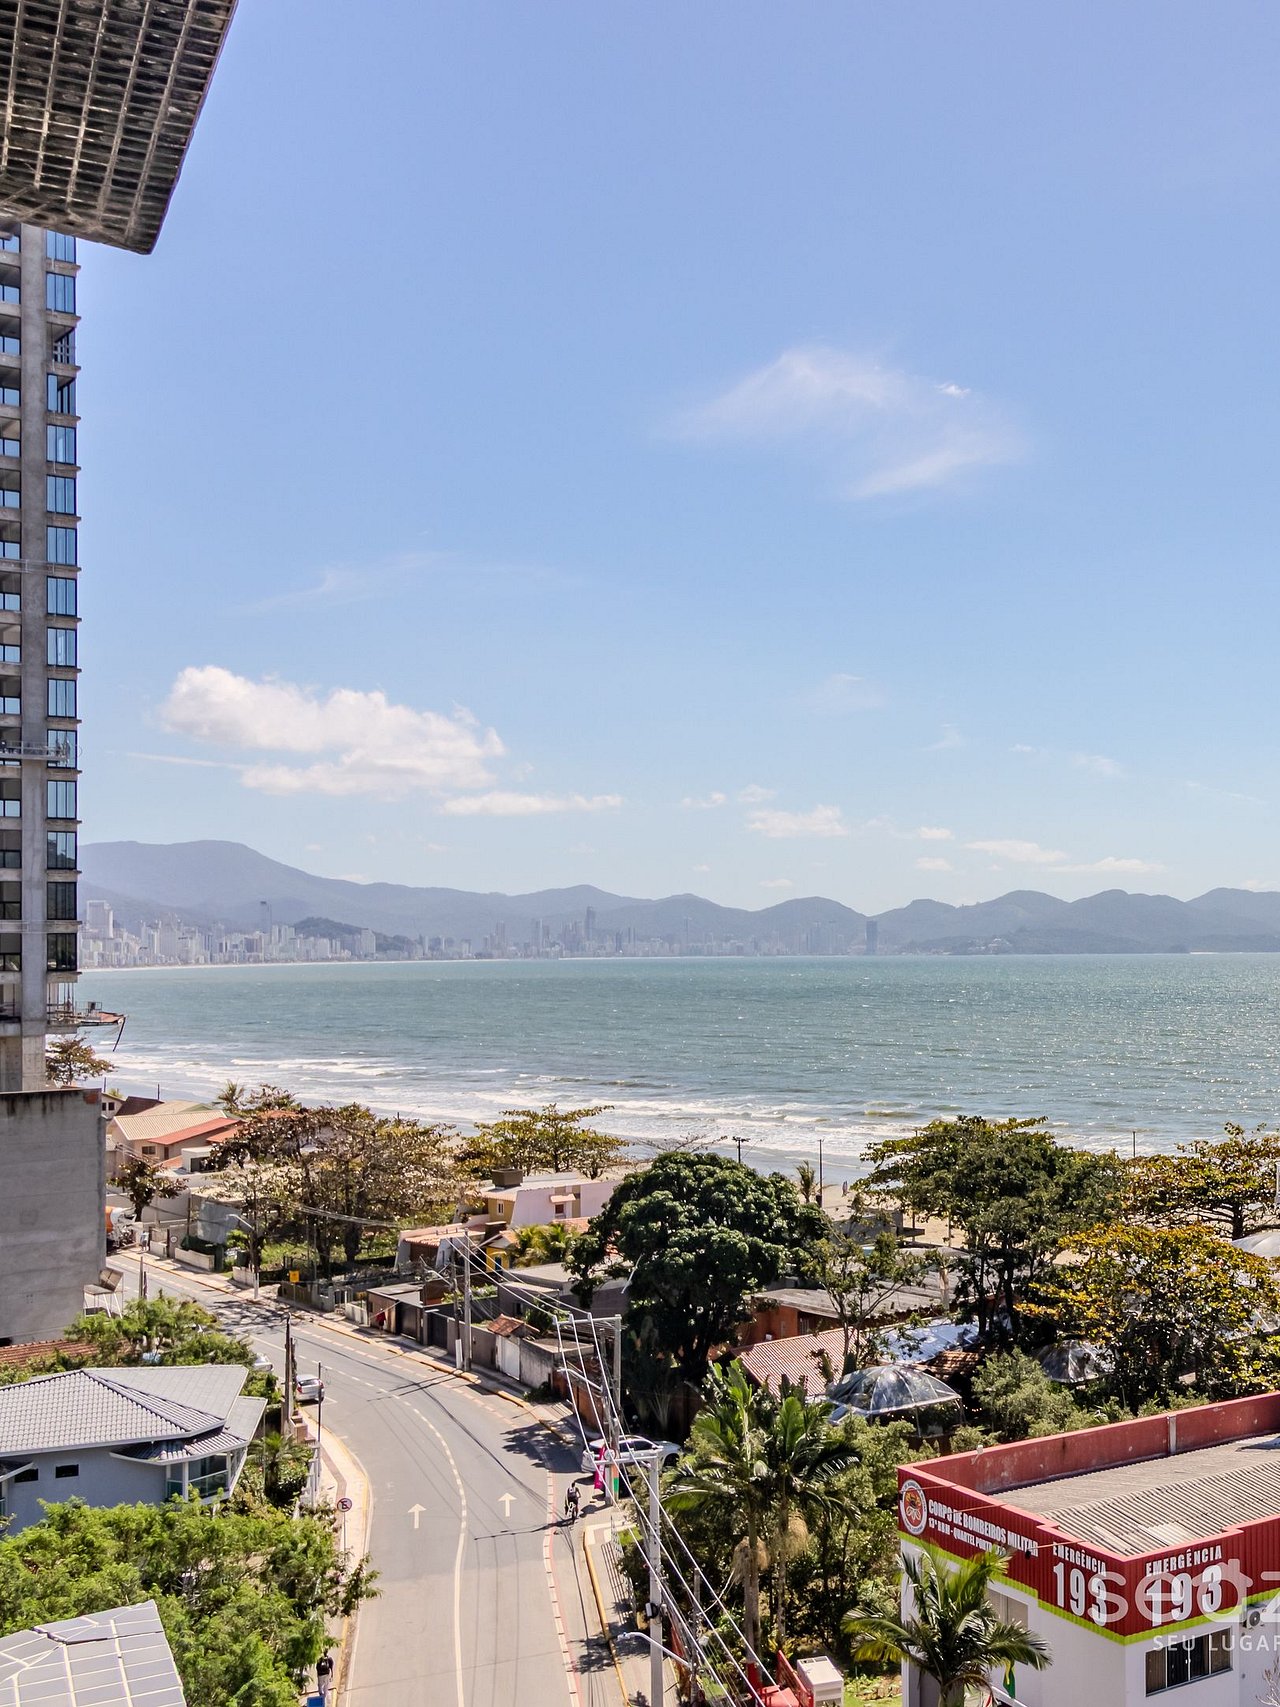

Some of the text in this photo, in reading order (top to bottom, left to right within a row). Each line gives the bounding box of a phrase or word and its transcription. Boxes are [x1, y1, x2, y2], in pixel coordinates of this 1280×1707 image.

[928, 1499, 953, 1522] CORPO
[953, 1508, 963, 1526] DE
[962, 1513, 1007, 1544] BOMBEIROS
[1007, 1530, 1039, 1557] MILITAR
[1052, 1541, 1107, 1576] EMERGÊNCIA
[1146, 1545, 1223, 1577] EMERGÊNCIA
[1053, 1561, 1108, 1627] 193
[1146, 1565, 1223, 1627] 193
